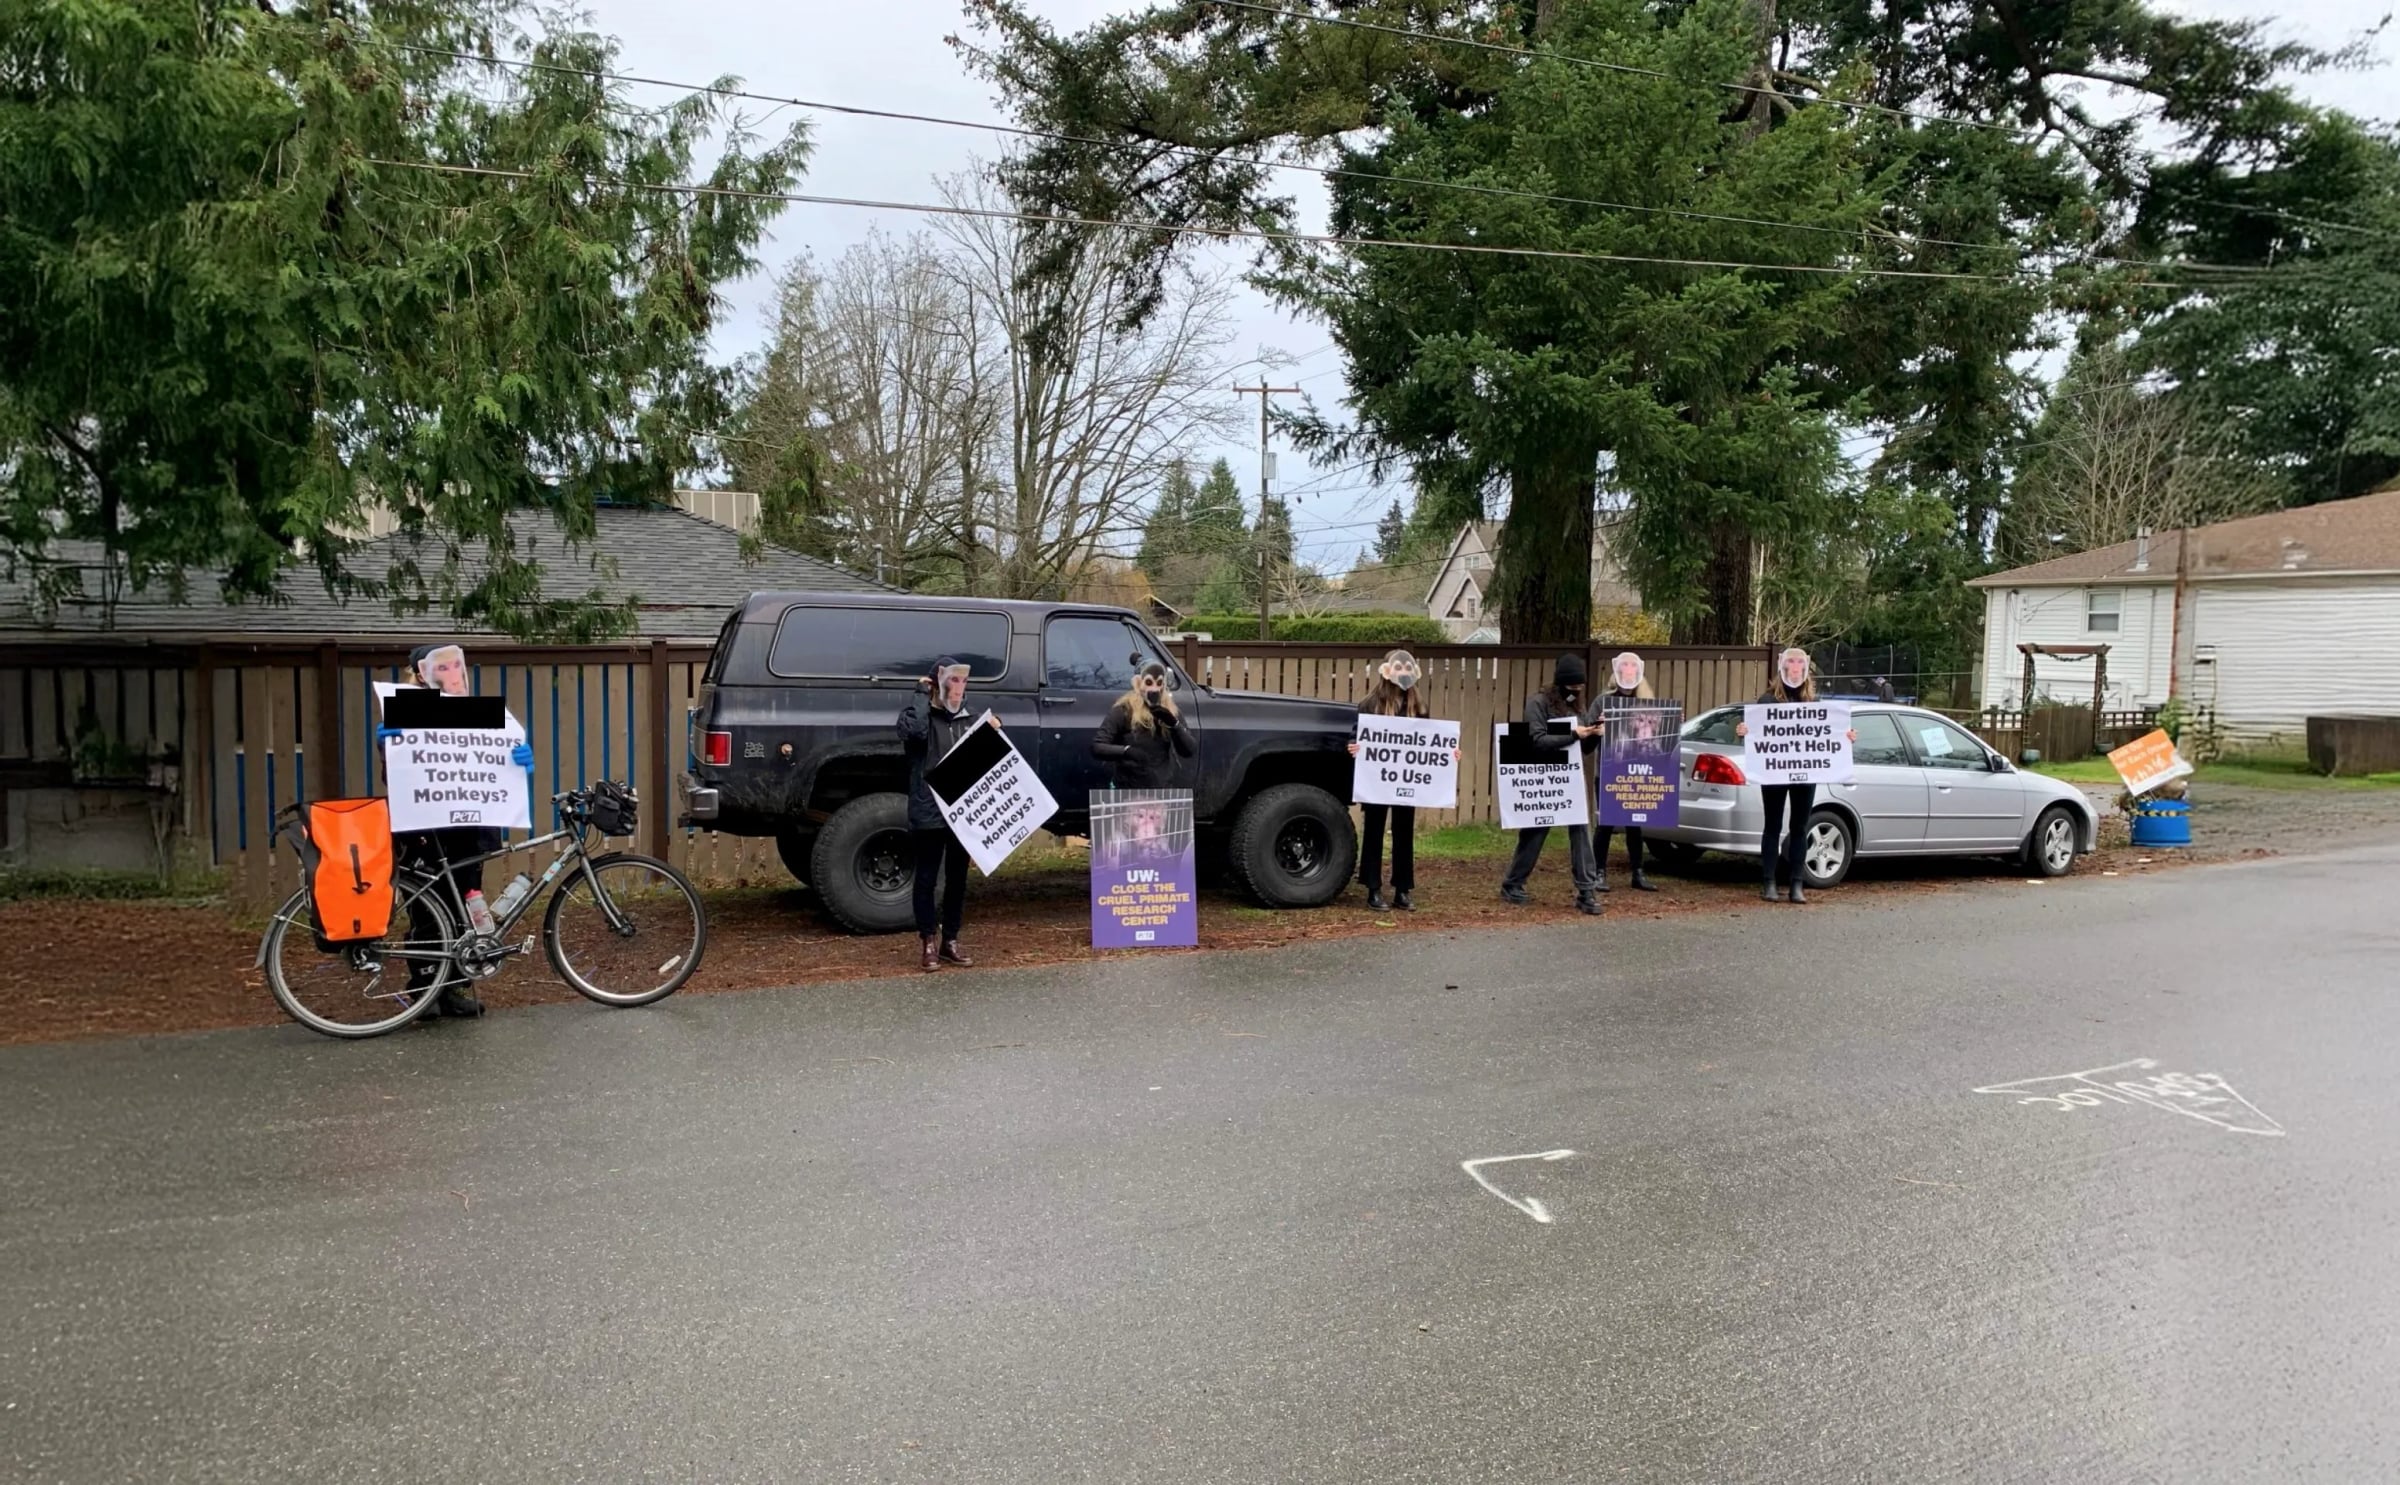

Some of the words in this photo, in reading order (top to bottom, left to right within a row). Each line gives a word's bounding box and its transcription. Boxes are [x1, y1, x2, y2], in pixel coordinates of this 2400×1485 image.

[1767, 706, 1827, 721] Hurting
[1763, 724, 1831, 737] Monkeys
[391, 733, 418, 746] Do
[424, 731, 522, 748] Neighbors
[1359, 728, 1426, 746] Animals
[1430, 734, 1457, 748] Are
[1754, 740, 1801, 753] Won't
[1805, 739, 1841, 754] Help
[412, 750, 467, 764] Know
[473, 751, 506, 765] You
[1365, 747, 1401, 763] NOT
[1405, 750, 1449, 767] OURS
[1500, 767, 1515, 775] Do
[1518, 762, 1580, 775] Neighbors
[1628, 764, 1653, 775] UW:
[1765, 758, 1831, 770] Humans
[425, 769, 497, 783] Torture
[1381, 768, 1398, 782] to
[1402, 769, 1432, 784] Use
[1512, 778, 1544, 787] Know
[1547, 775, 1570, 785] You
[1616, 775, 1645, 783] CLOSE
[948, 806, 965, 824] Do
[963, 754, 1020, 808] Neighbors
[1519, 789, 1564, 799] Torture
[1605, 784, 1634, 792] CRUEL
[414, 788, 508, 804] Monkeys?
[965, 794, 996, 826] Know
[994, 775, 1018, 795] You
[1616, 793, 1664, 801] RESEARCH
[978, 792, 1021, 831] Torture
[1514, 799, 1572, 812] Monkeys?
[982, 796, 1035, 849] Monkeys?
[1127, 870, 1160, 883] UW:
[1112, 884, 1149, 894] CLOSE
[1153, 883, 1176, 892] THE
[1098, 895, 1136, 905] CRUEL
[1139, 893, 1190, 904] PRIMATE
[1112, 904, 1176, 916] RESEARCH
[1122, 915, 1168, 926] CENTER
